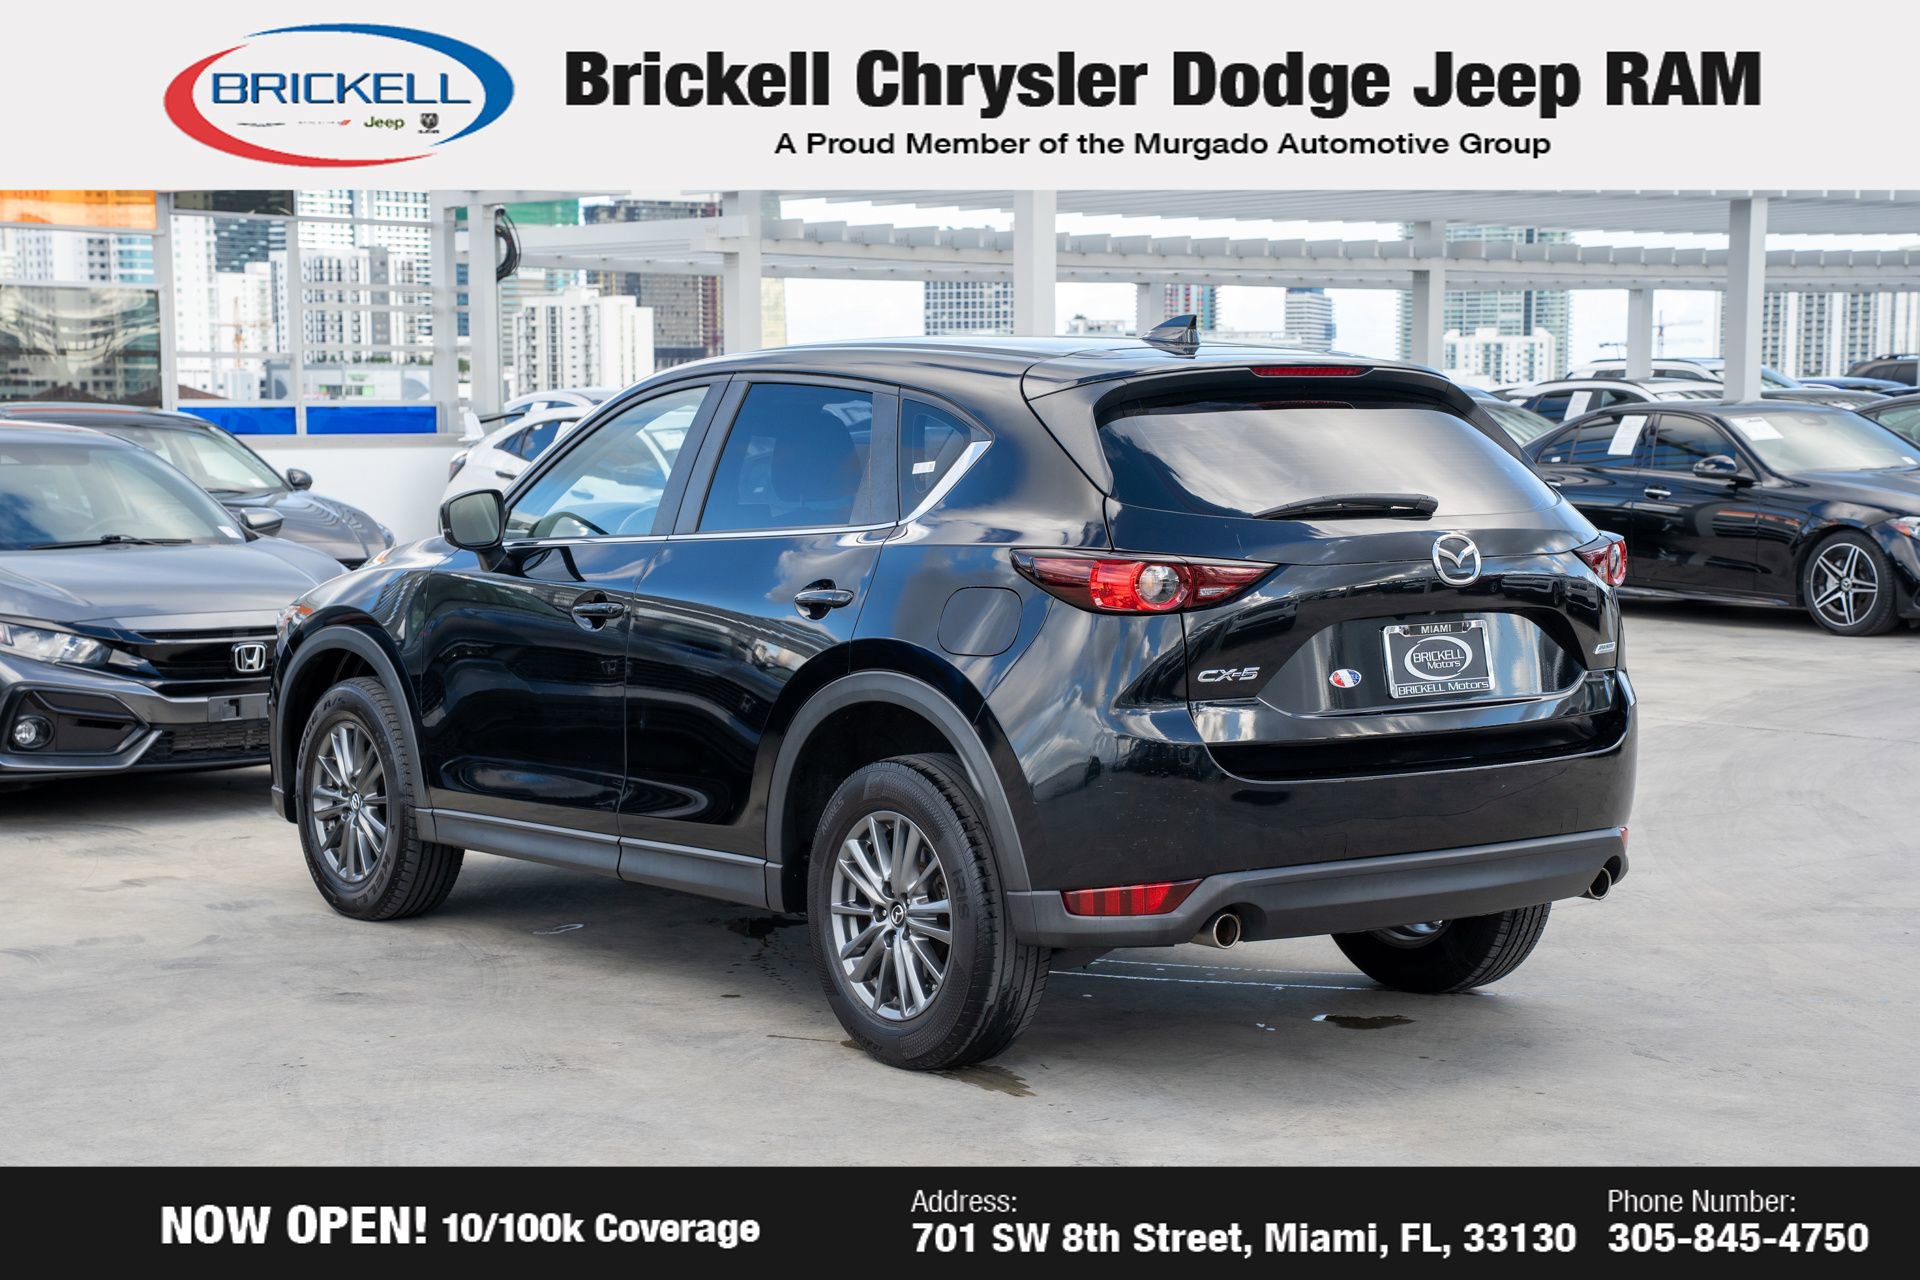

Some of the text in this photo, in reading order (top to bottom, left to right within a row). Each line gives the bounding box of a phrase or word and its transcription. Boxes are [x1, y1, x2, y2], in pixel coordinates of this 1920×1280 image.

[1421, 624, 1452, 634] MIAMI
[1413, 649, 1465, 663] BRICKELL
[1427, 660, 1461, 670] Motors
[1197, 666, 1260, 682] CX-5
[1398, 681, 1489, 695] BRICKELL Motors
